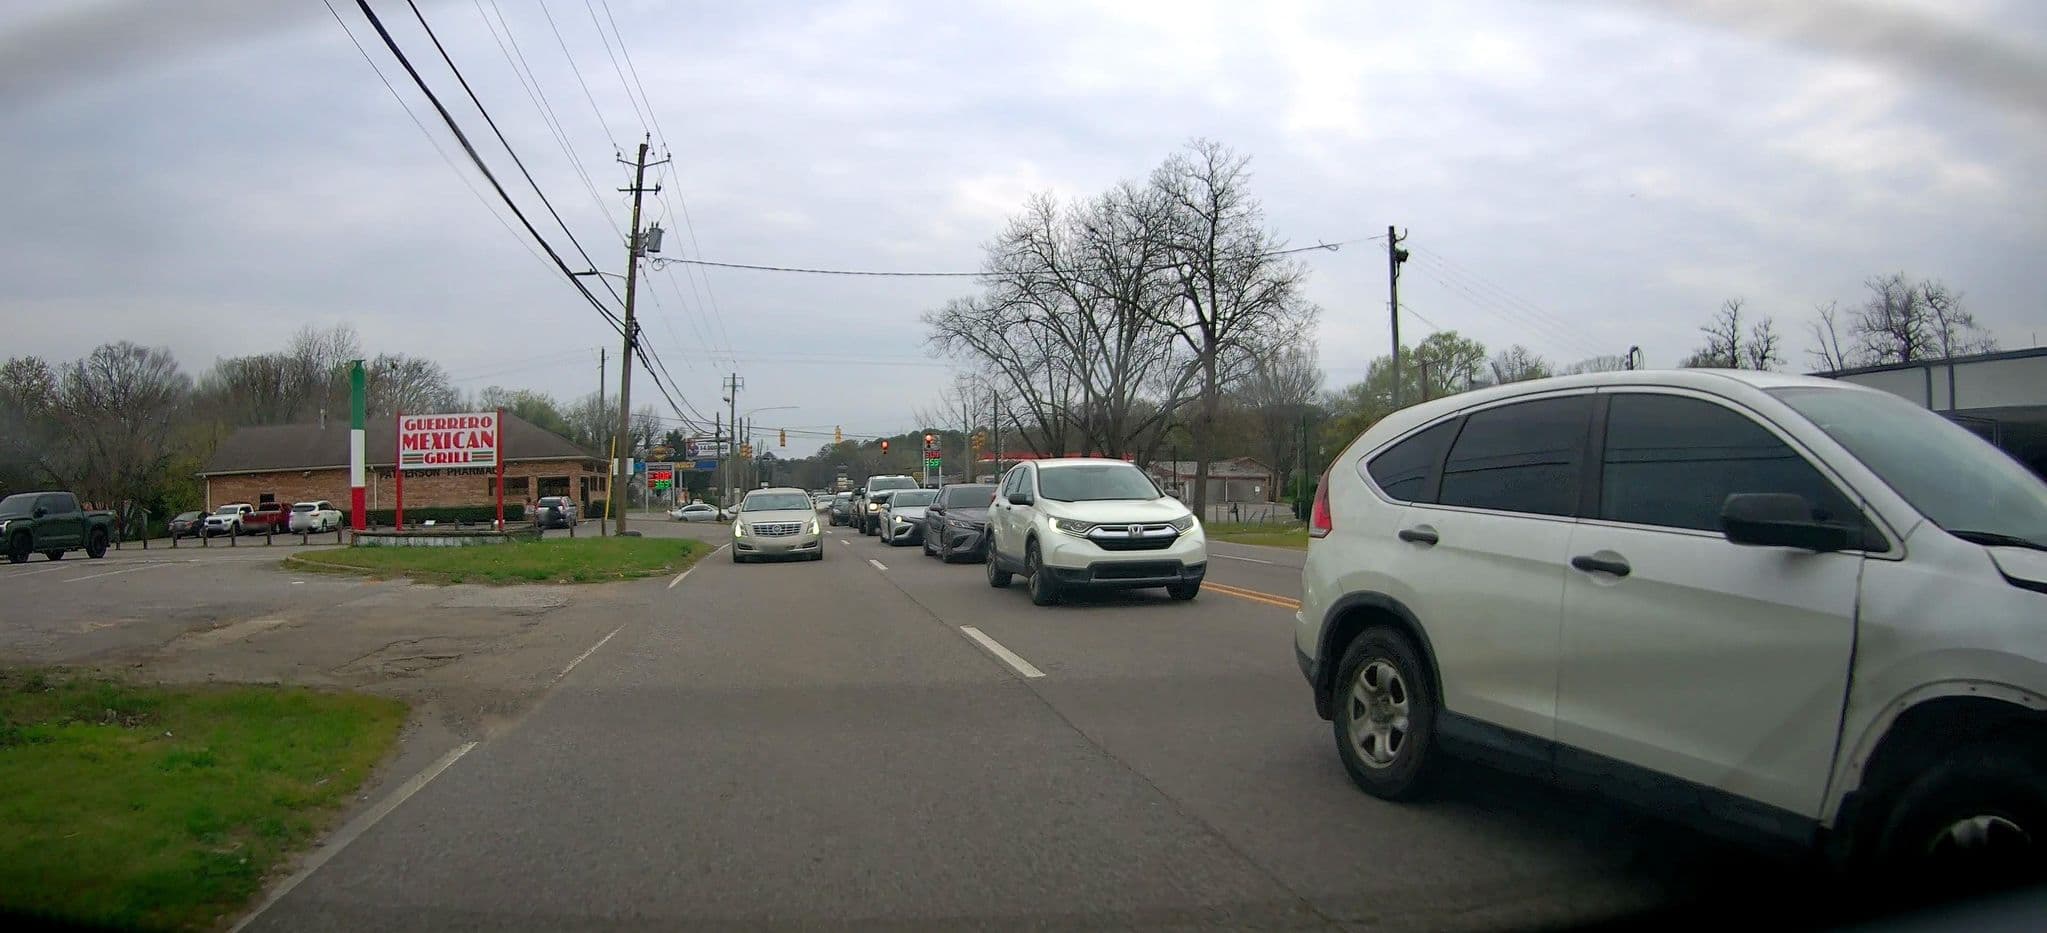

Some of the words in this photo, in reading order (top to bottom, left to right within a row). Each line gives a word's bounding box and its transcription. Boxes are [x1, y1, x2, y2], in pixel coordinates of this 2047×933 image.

[404, 416, 493, 431] GUERRERO
[402, 430, 494, 451] MEXICAN
[424, 451, 470, 464] GRILL
[447, 466, 504, 476] PHARMAC
